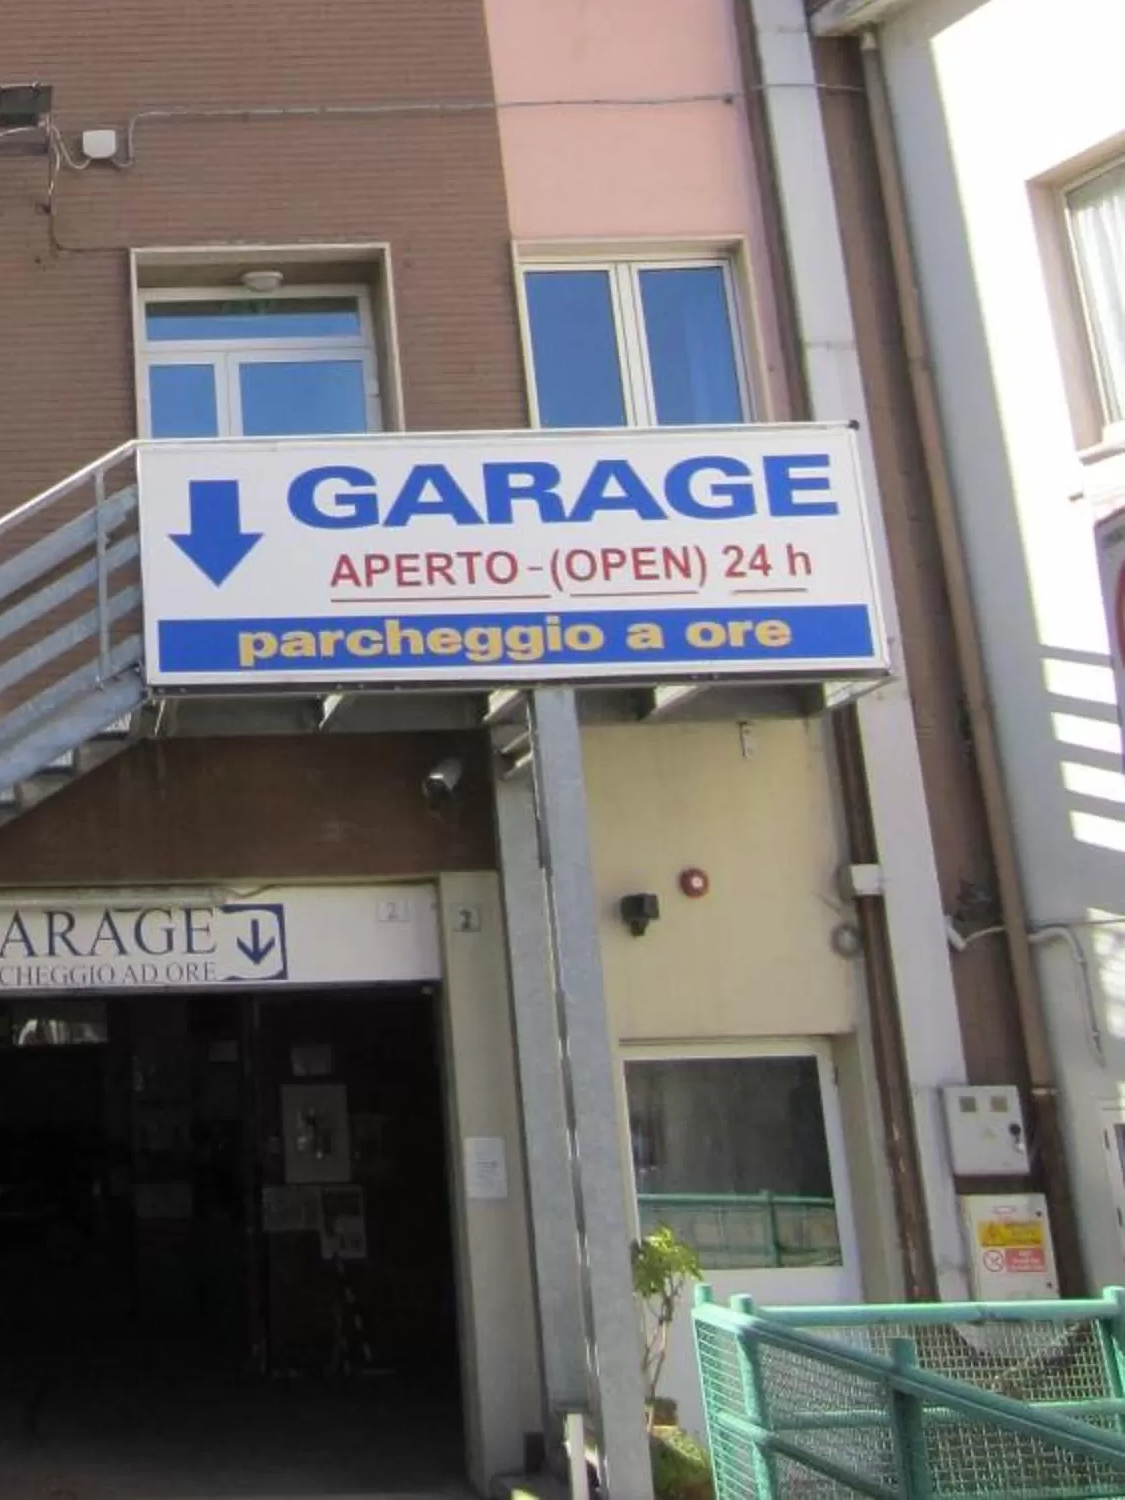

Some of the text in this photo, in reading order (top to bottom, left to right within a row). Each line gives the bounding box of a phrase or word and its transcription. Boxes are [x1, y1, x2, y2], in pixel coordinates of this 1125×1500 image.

[286, 453, 840, 530] GARAGE
[723, 545, 773, 580] 24
[787, 543, 813, 577] h
[238, 615, 792, 667] parcheggio a ore
[121, 964, 160, 984] AD
[165, 962, 217, 982] ORE
